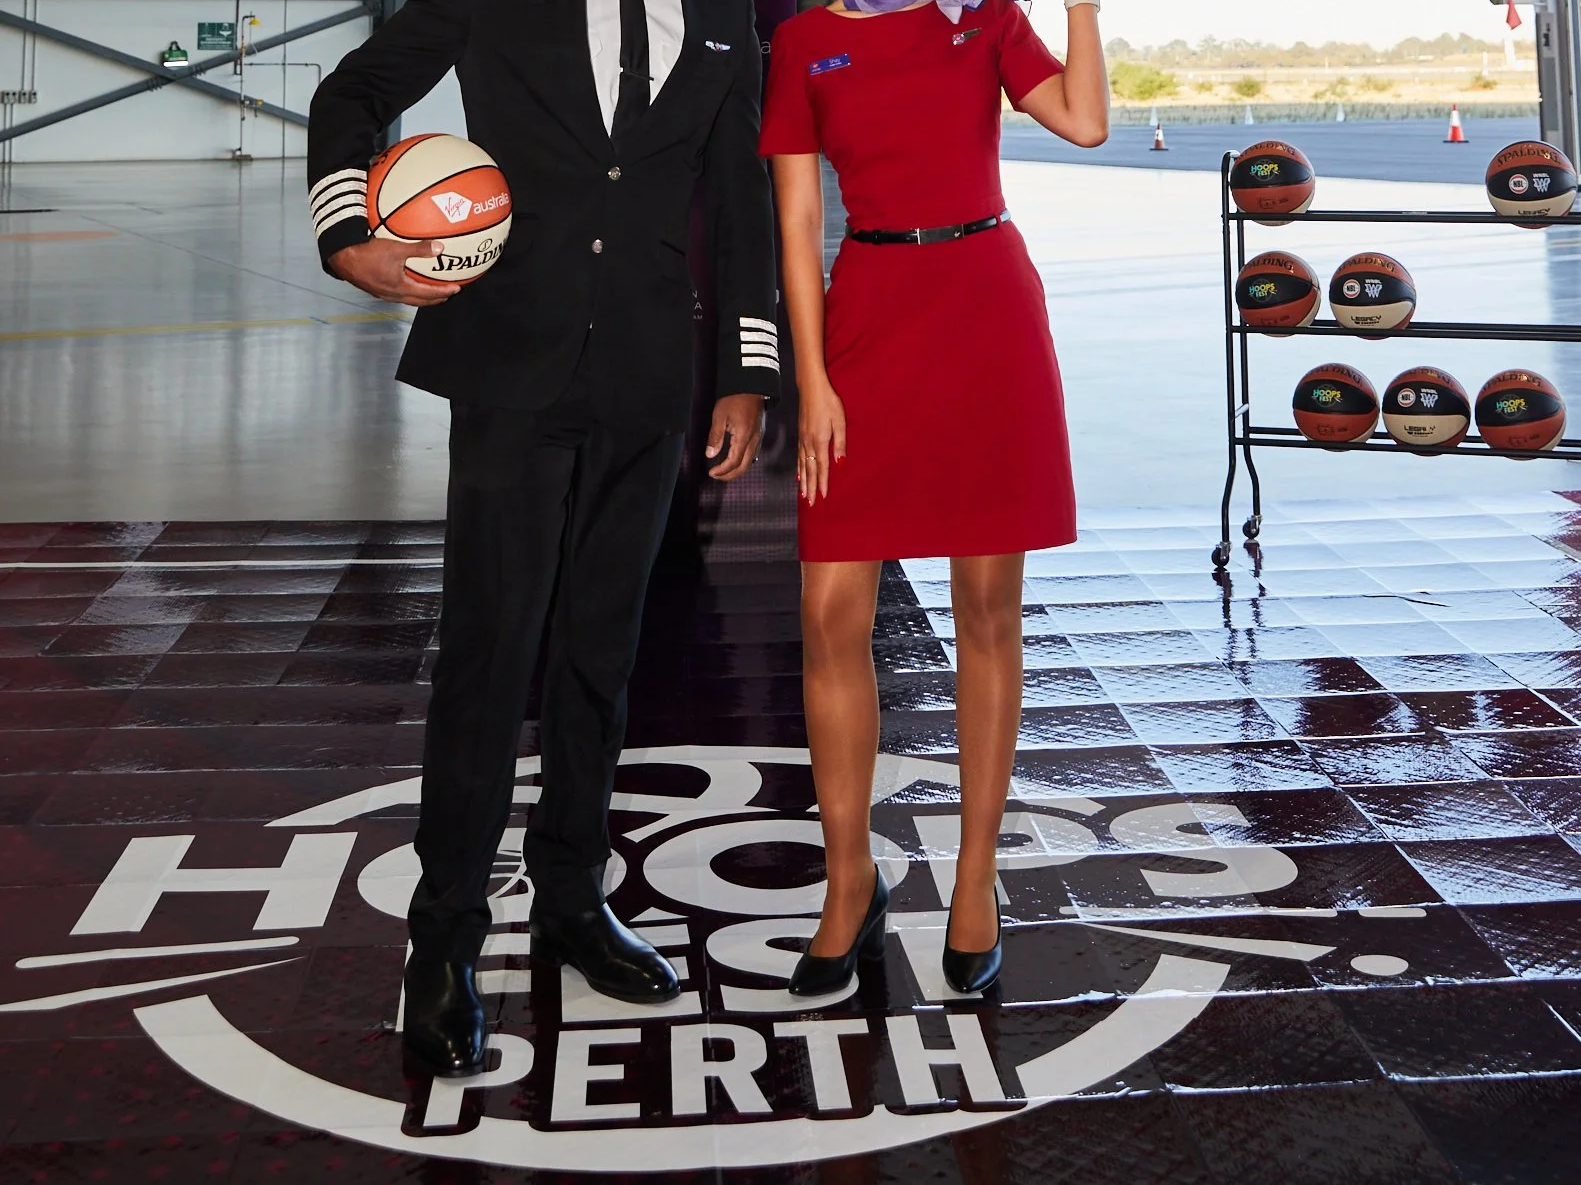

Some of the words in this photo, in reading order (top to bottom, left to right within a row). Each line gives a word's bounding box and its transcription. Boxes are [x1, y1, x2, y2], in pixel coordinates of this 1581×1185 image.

[1251, 163, 1279, 172] HOOPS
[445, 197, 465, 217] Virgin
[1248, 282, 1276, 294] HOOPS
[1312, 389, 1342, 399] HOOPS
[1496, 398, 1526, 409] HOOPS
[1503, 405, 1518, 413] FEST
[423, 1013, 1004, 1129] PERTH
